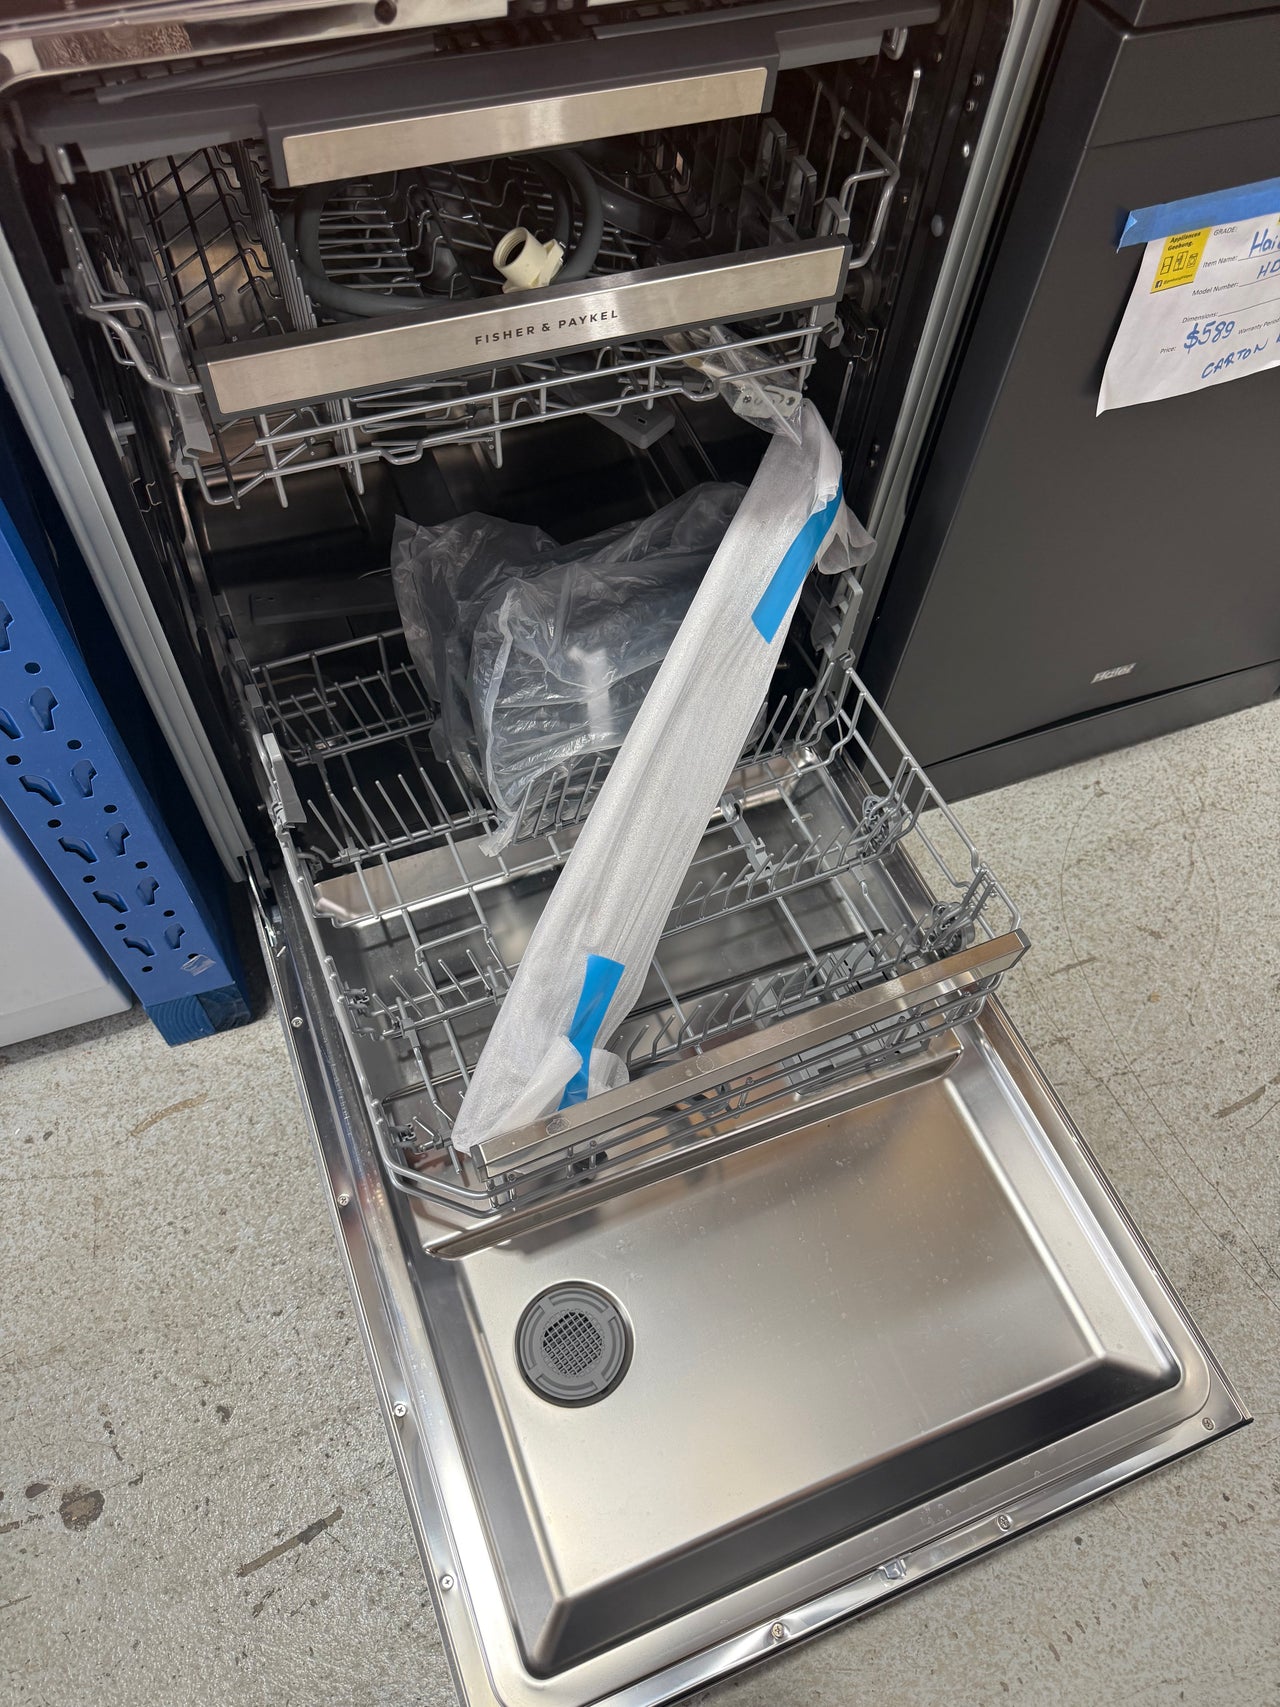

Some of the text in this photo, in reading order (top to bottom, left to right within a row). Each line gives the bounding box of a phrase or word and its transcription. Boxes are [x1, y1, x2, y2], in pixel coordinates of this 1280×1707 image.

[1169, 231, 1201, 243] Appliances
[1213, 226, 1238, 236] GRADE:
[1202, 255, 1238, 268] Item Name:
[1192, 281, 1239, 296] Model Number:
[1182, 311, 1219, 323] Dimensions:
[475, 309, 619, 345] FISHER & PAYKEL
[1238, 324, 1262, 334] Warranty
[1183, 320, 1235, 354] $589
[1160, 346, 1176, 354] Price:
[1201, 338, 1269, 379] CARTON
